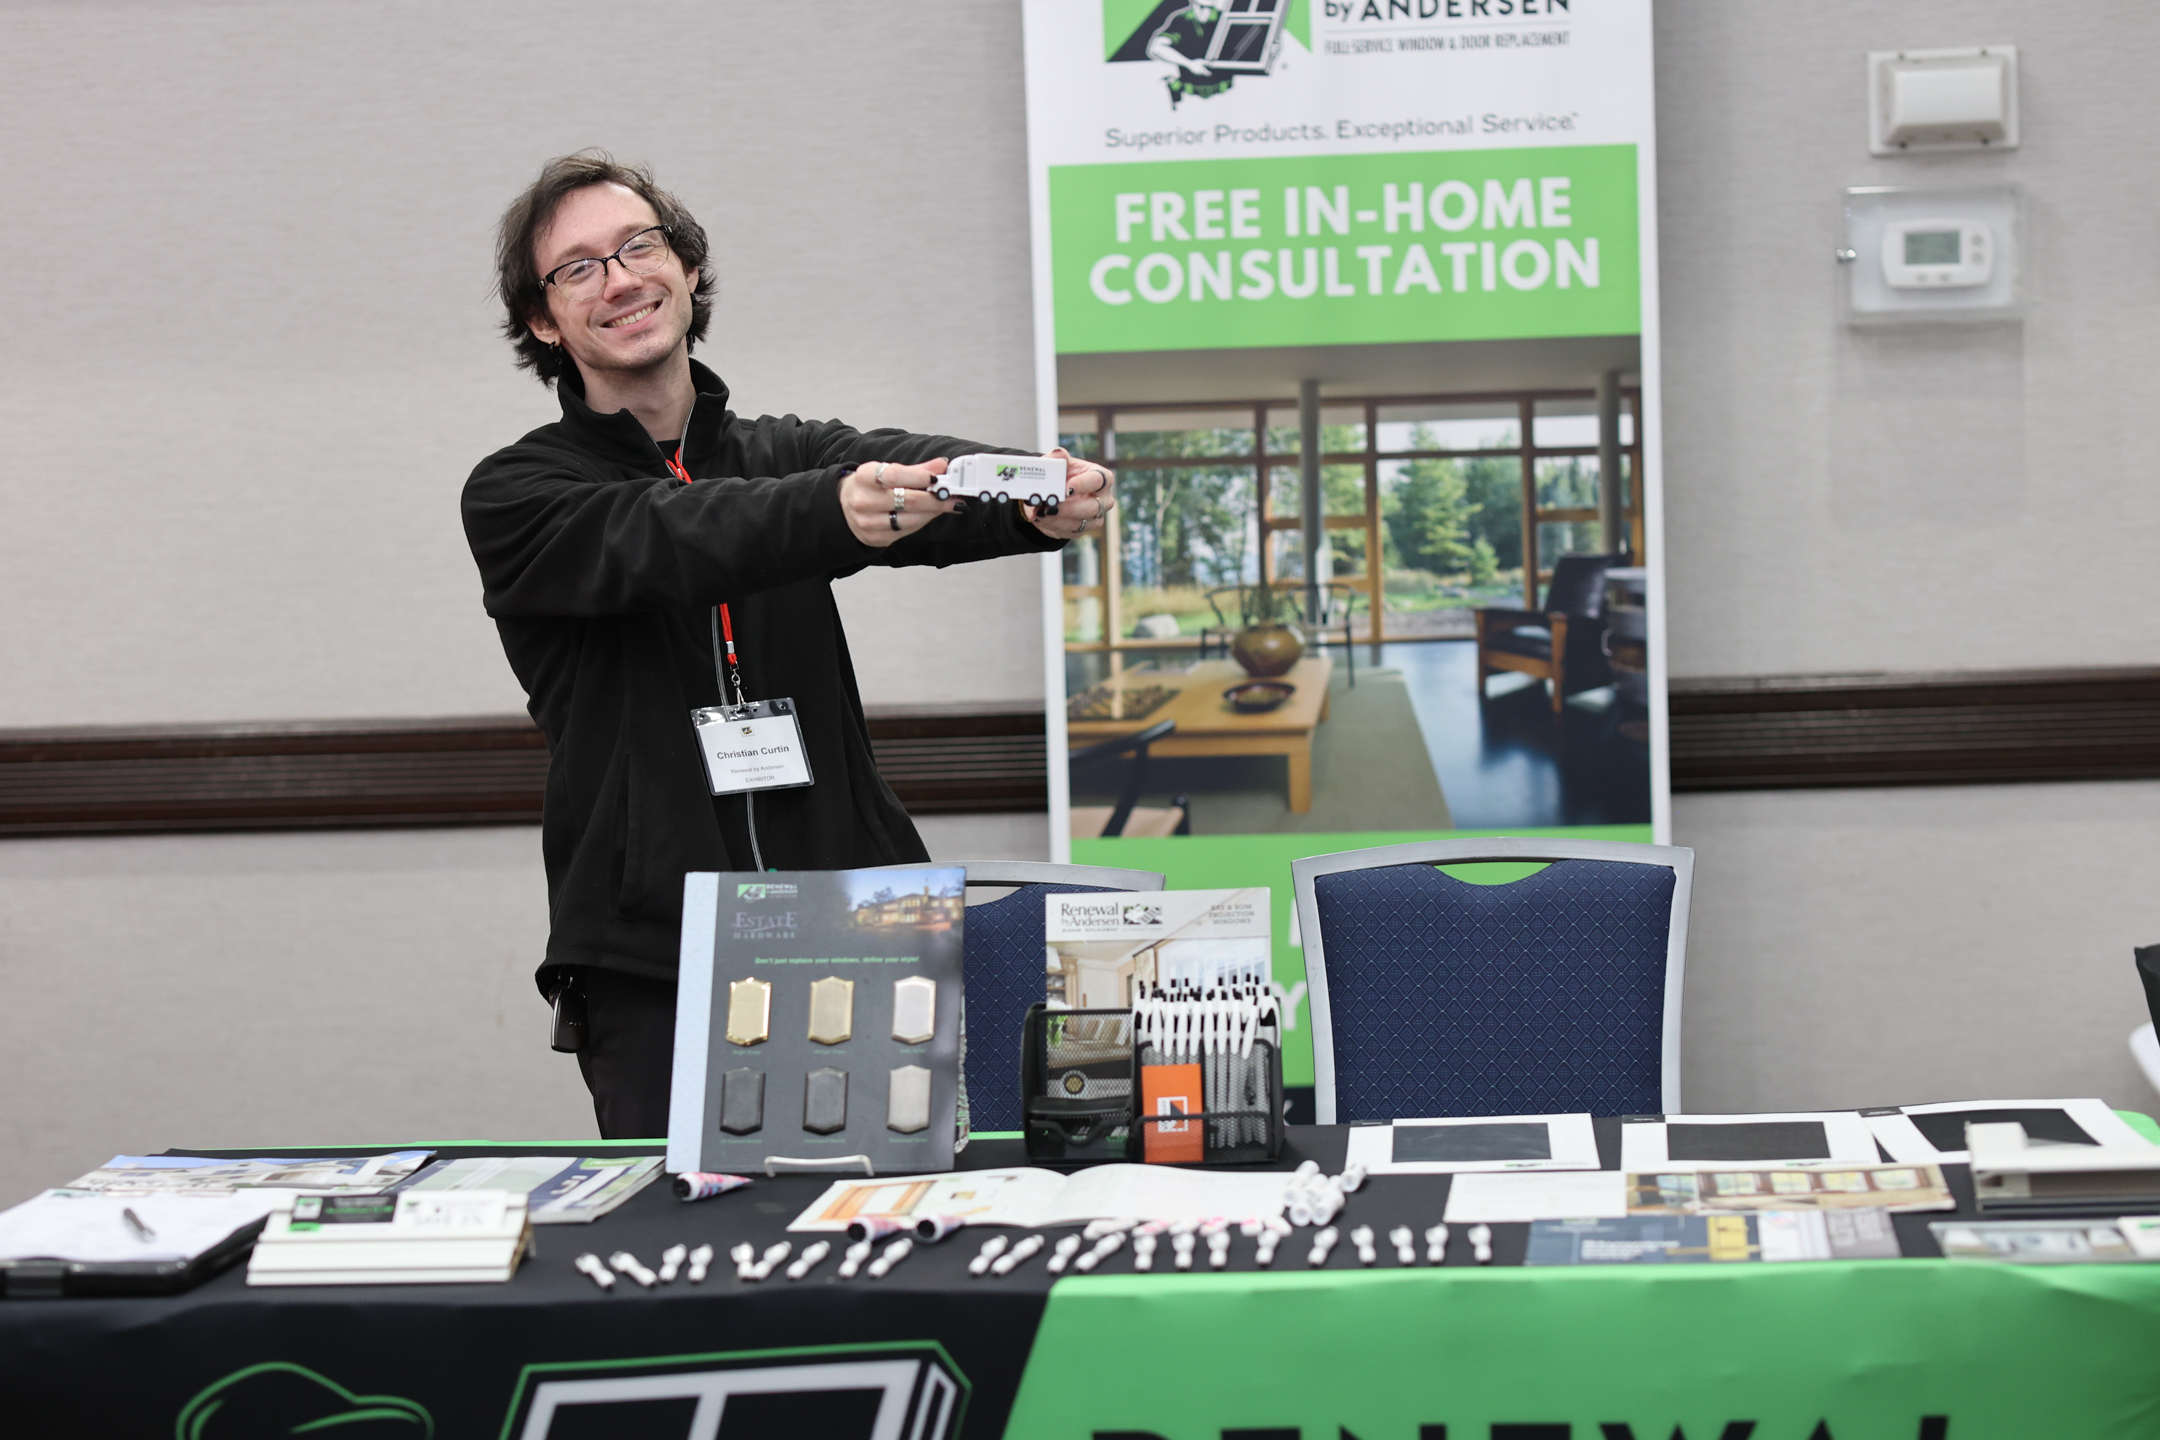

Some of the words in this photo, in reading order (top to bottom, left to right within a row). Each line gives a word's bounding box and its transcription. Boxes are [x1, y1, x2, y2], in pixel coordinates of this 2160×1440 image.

[1105, 127, 1207, 151] Superior
[1214, 122, 1329, 143] Products.
[1336, 114, 1474, 142] Exceptional
[1114, 188, 1261, 243] FREE
[1284, 176, 1572, 237] IN-HOME
[1089, 237, 1601, 305] CONSULTATION
[717, 749, 758, 759] Christian
[761, 745, 789, 755] Curtin
[745, 775, 775, 783] EXHIBITOR
[1061, 902, 1119, 916] Renewal
[1209, 910, 1255, 918] PROJECTION
[1070, 914, 1120, 926] Andersen
